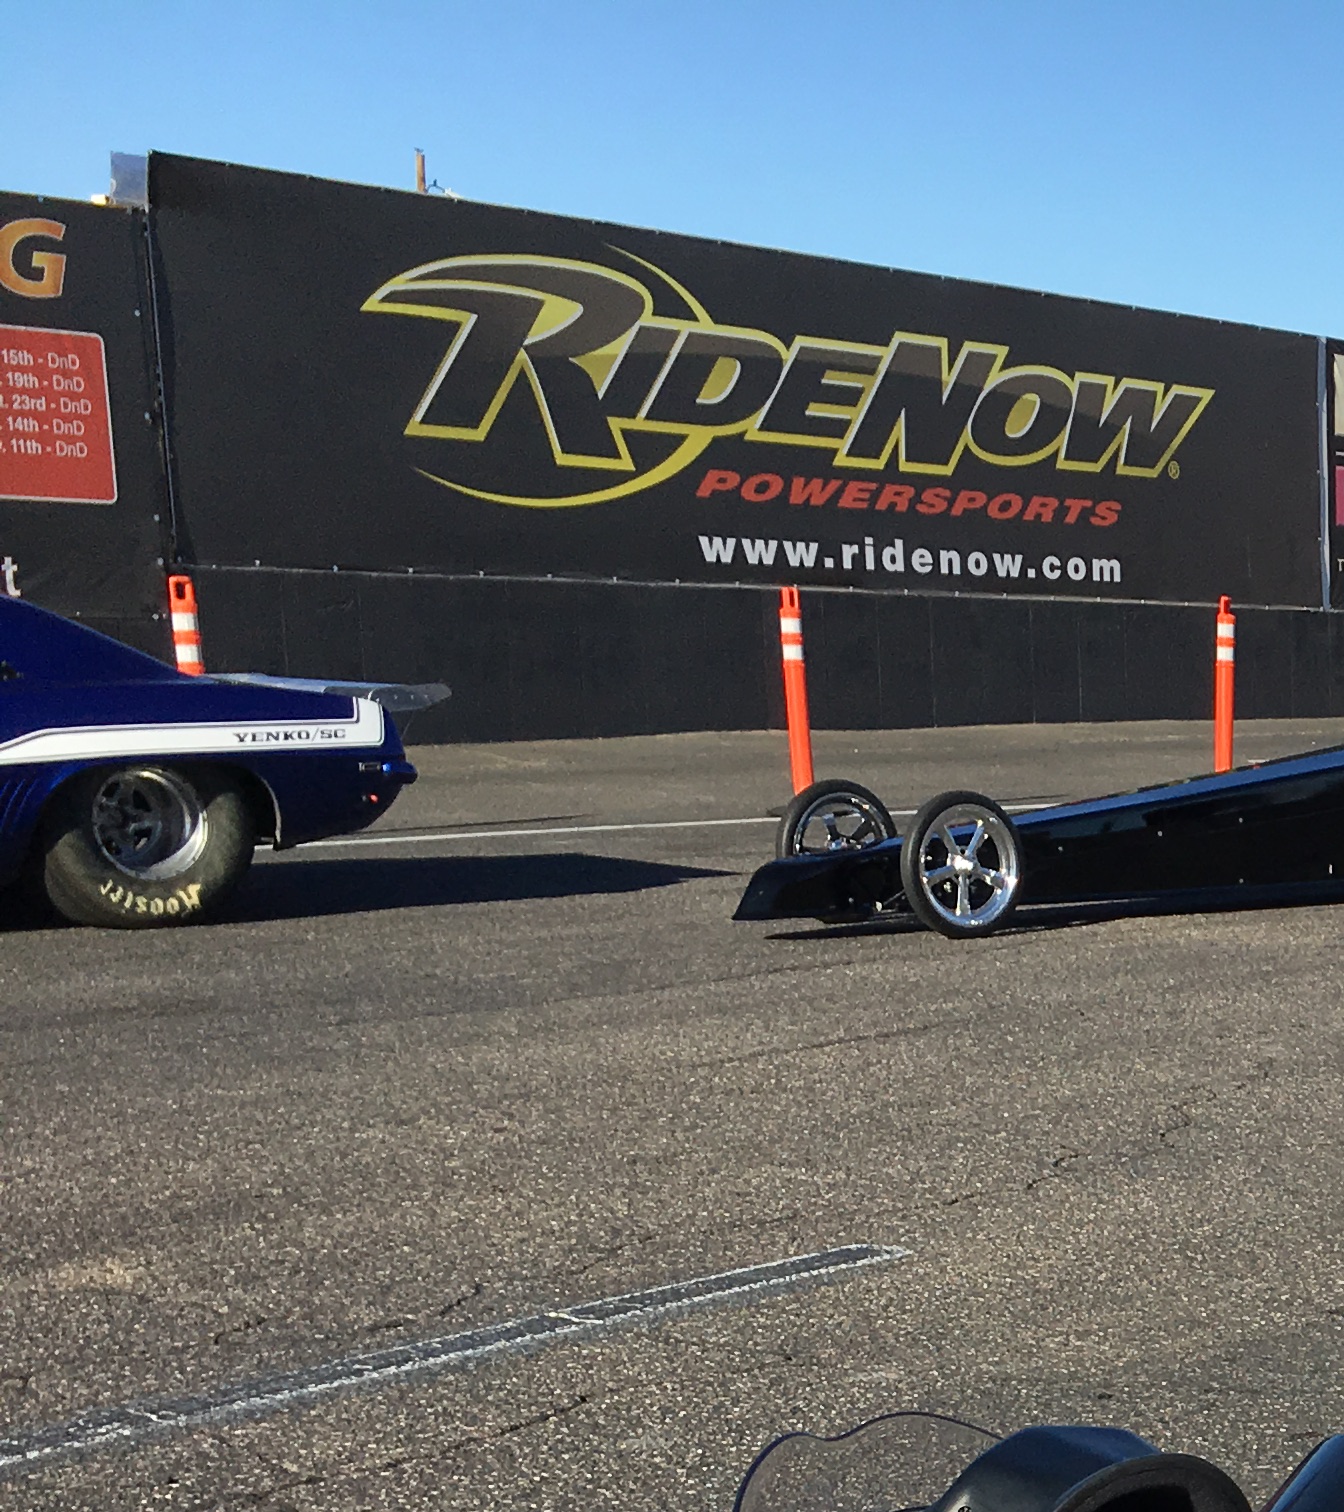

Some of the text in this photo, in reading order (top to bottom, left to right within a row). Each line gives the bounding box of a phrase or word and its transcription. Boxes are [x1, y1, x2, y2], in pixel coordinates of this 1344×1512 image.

[47, 352, 80, 370] DnD
[6, 371, 39, 389] 19th
[52, 375, 85, 392] DnD
[12, 394, 46, 411] 23rd
[60, 397, 92, 415] DnD
[6, 415, 39, 432] 14th
[52, 418, 85, 436] DnD
[10, 438, 42, 455] 11th
[55, 440, 88, 457] DnD
[695, 469, 1122, 527] POWERSPORTS
[697, 534, 1123, 583] www.ridenow.com
